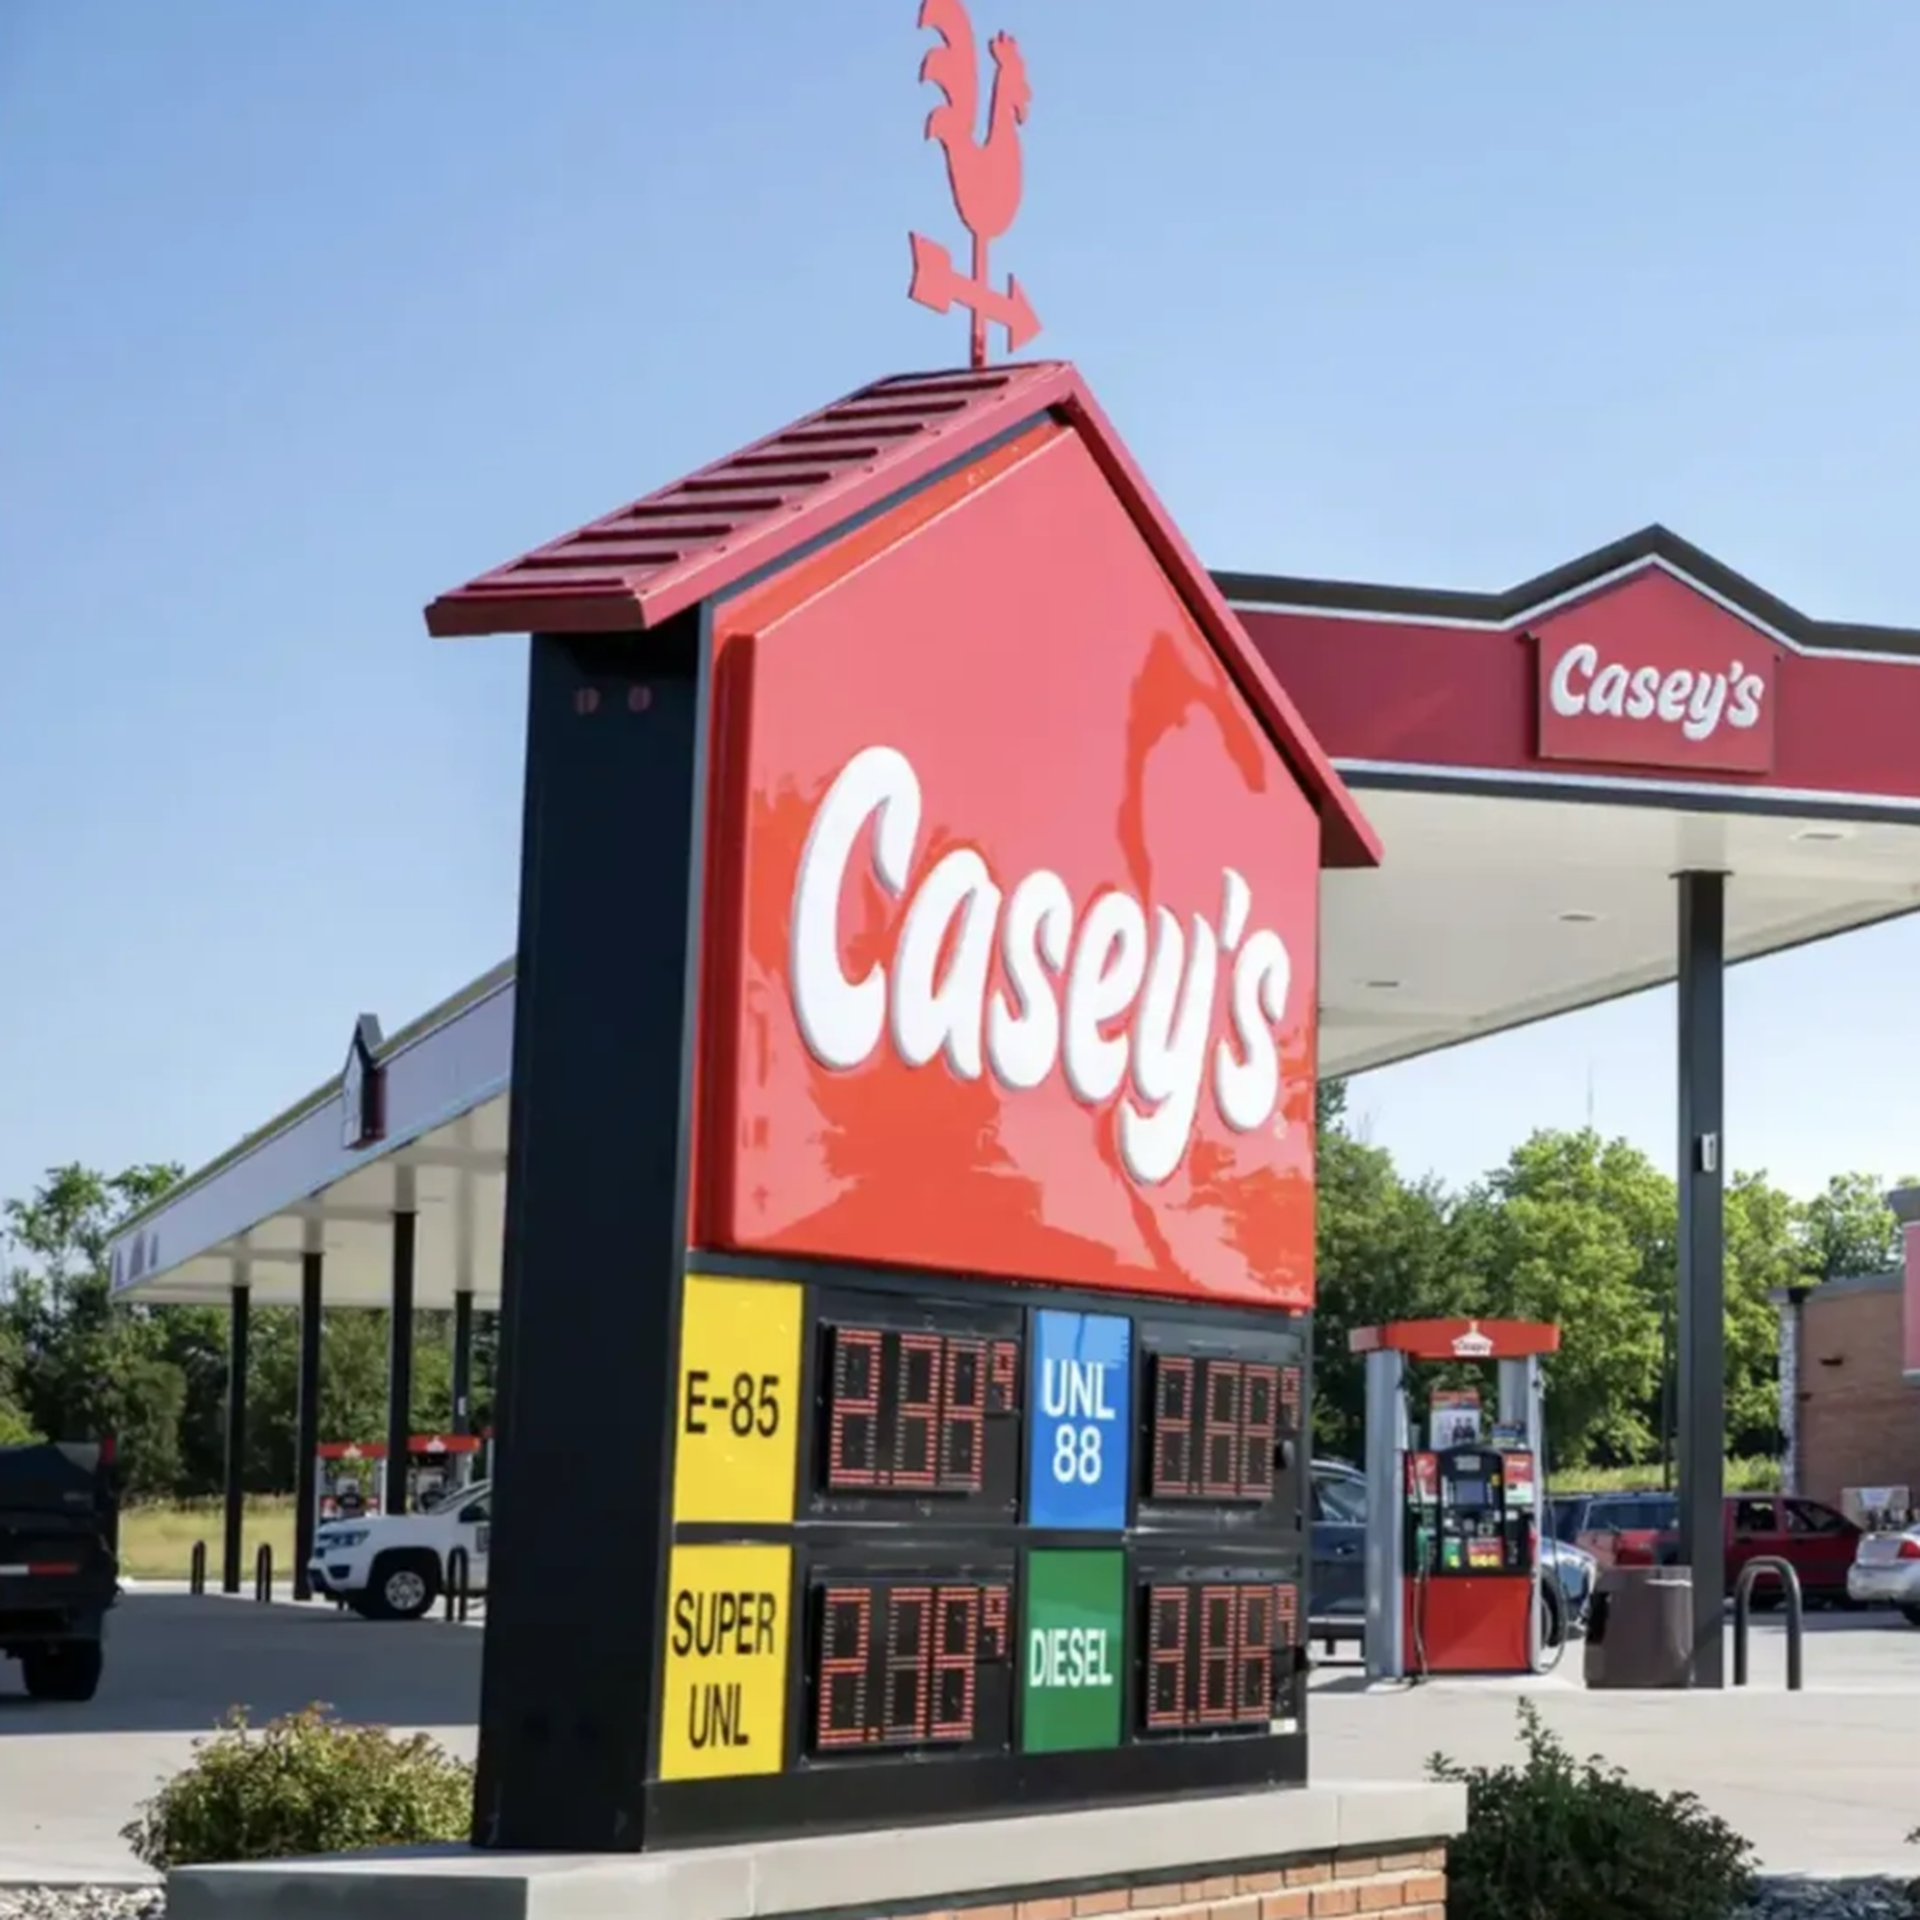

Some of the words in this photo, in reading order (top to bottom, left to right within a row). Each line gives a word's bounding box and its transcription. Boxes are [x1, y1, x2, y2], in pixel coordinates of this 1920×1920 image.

[1549, 642, 1765, 741] Casey's
[791, 746, 1292, 1184] Casey's
[685, 1371, 780, 1438] E-85
[1043, 1358, 1116, 1420] UNL
[1053, 1423, 1102, 1484] 88
[672, 1590, 775, 1656] SUPER
[1028, 1626, 1114, 1688] DIESEL
[688, 1684, 750, 1748] UNL
